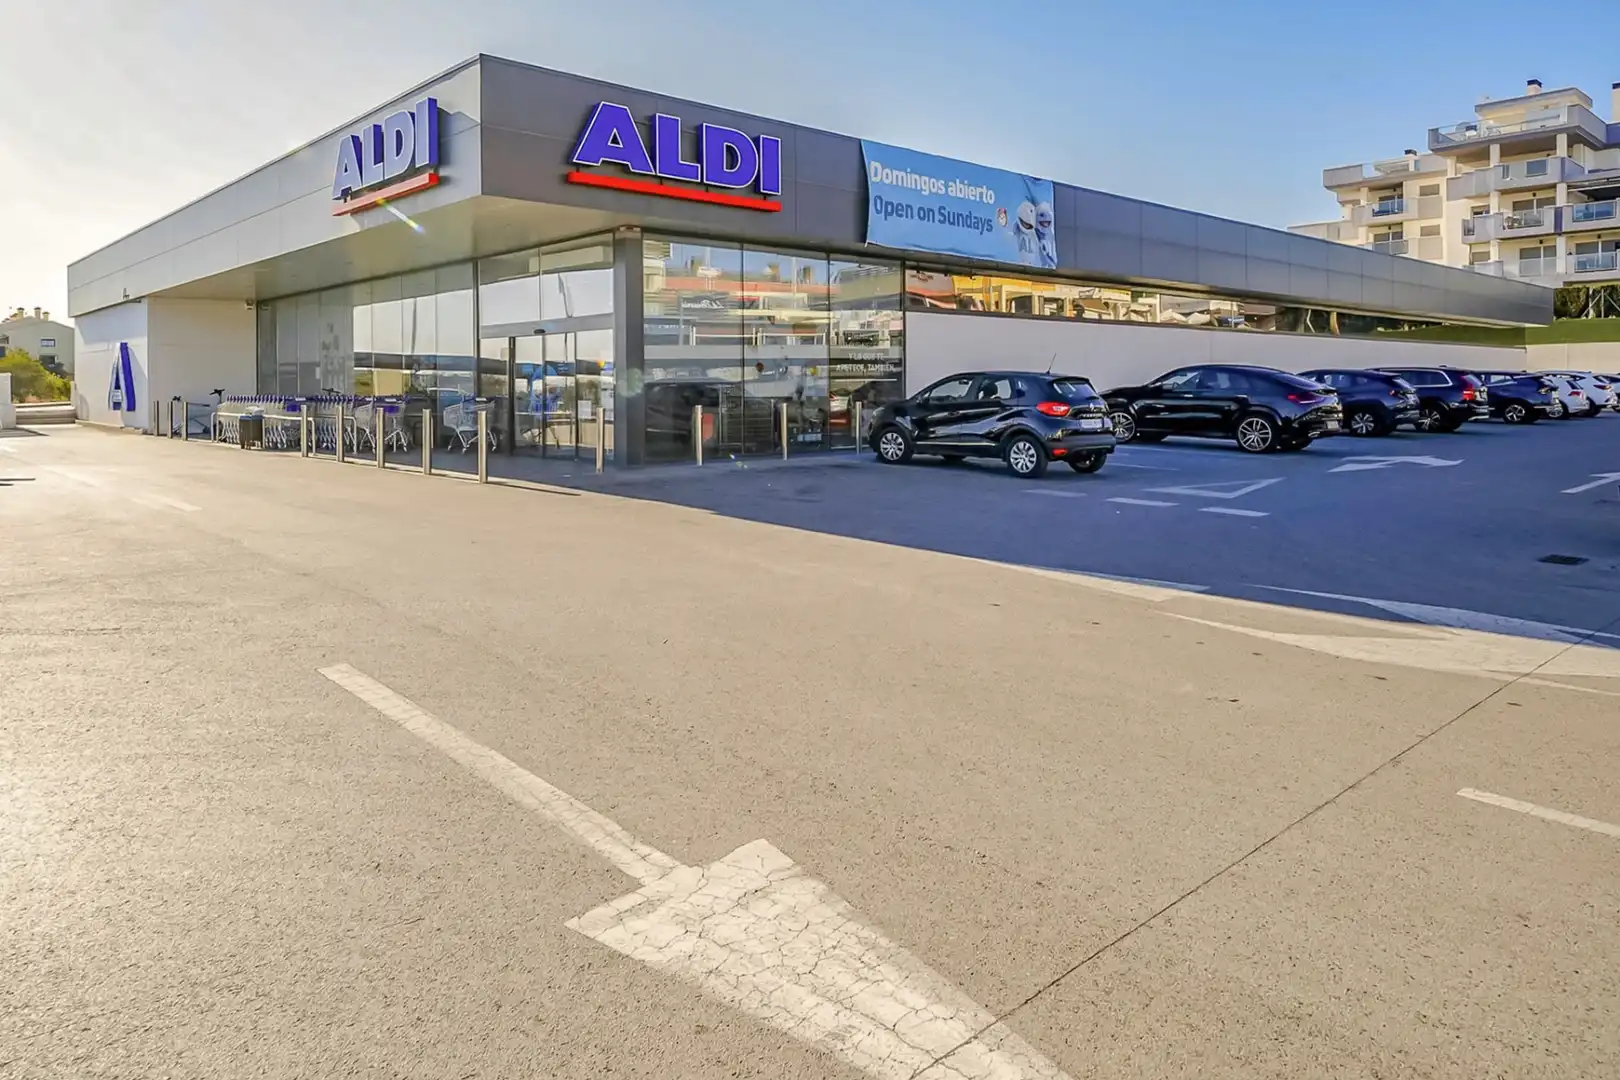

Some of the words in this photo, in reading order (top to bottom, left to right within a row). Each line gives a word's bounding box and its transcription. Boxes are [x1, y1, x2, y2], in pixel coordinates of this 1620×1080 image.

[332, 97, 438, 200] ALDI
[571, 101, 782, 196] ALDI
[869, 161, 945, 196] Domingos
[947, 179, 995, 205] abierto
[873, 195, 914, 221] Open
[917, 206, 936, 224] on
[938, 206, 993, 236] Sundays
